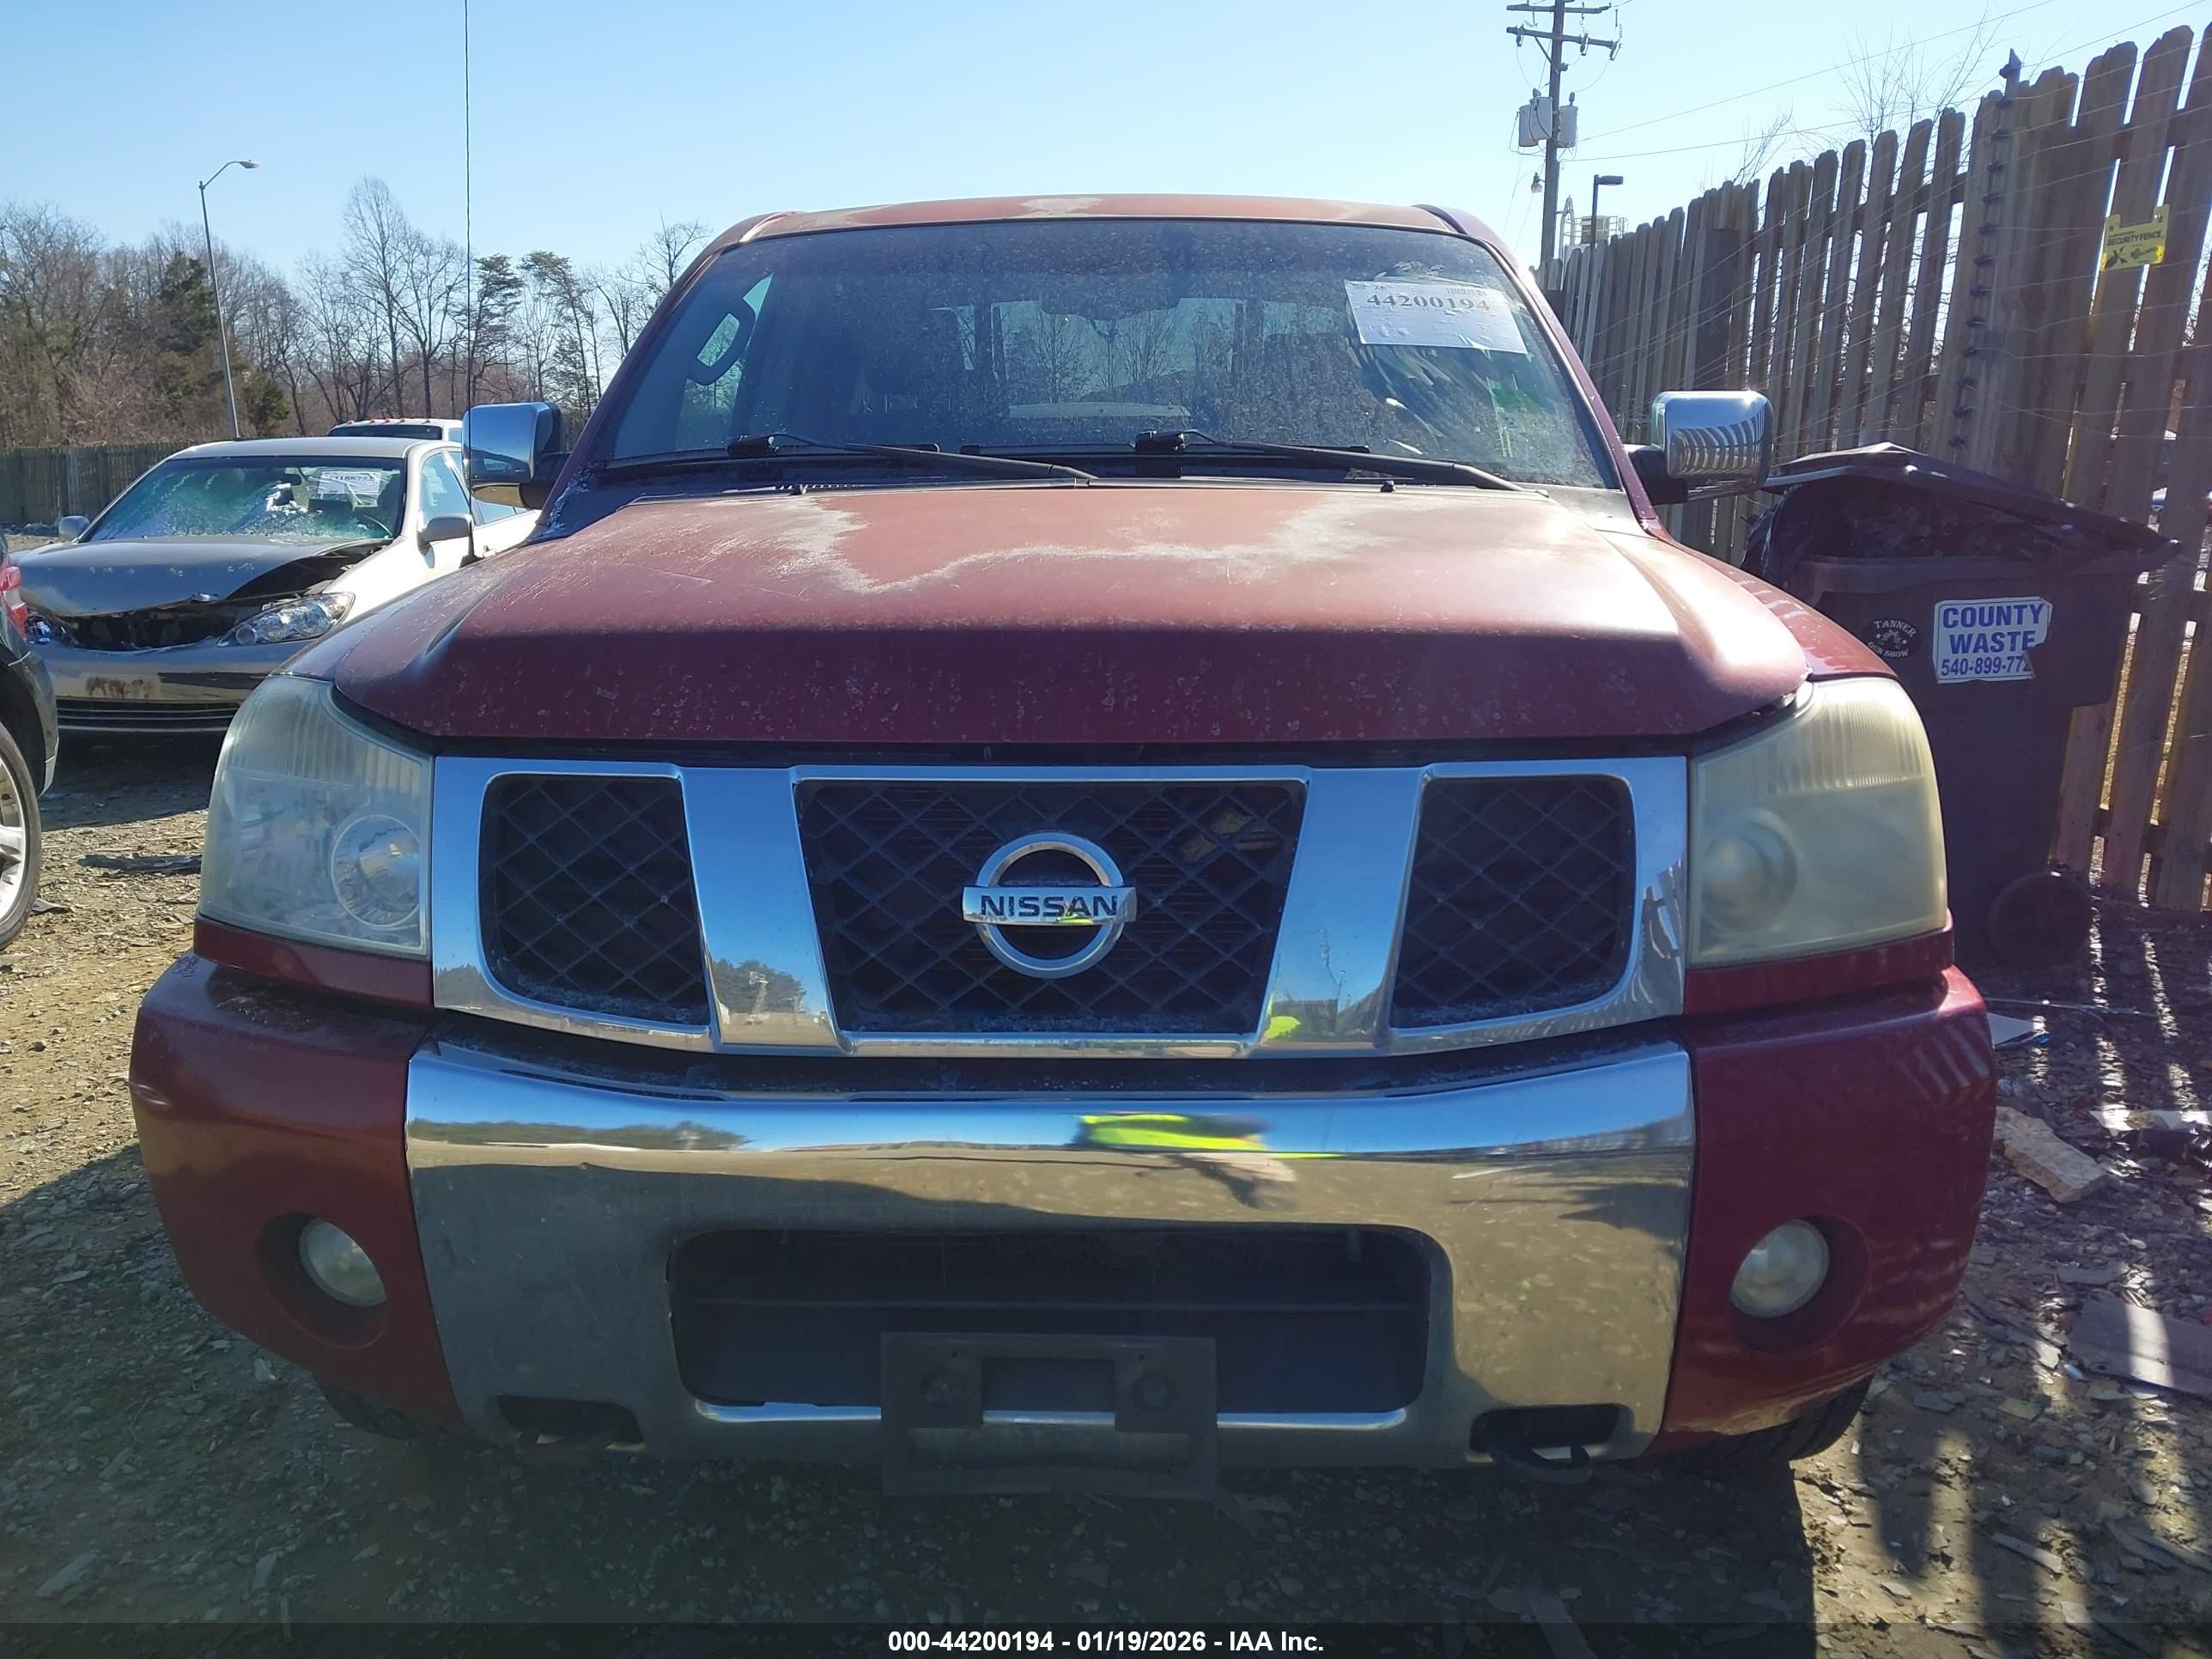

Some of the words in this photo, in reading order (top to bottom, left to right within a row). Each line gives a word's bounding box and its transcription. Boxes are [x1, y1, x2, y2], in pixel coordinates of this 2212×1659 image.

[2107, 234, 2139, 246] SECURITY
[2140, 230, 2161, 241] FENCE
[1367, 294, 1490, 310] 44200194
[1942, 604, 2044, 628] COUNTY
[1874, 619, 1917, 637] TANNER
[1868, 641, 1884, 655] GUN
[1884, 648, 1909, 658] SHOW
[1949, 630, 2035, 654] WASTE
[981, 895, 1117, 917] NISSAN
